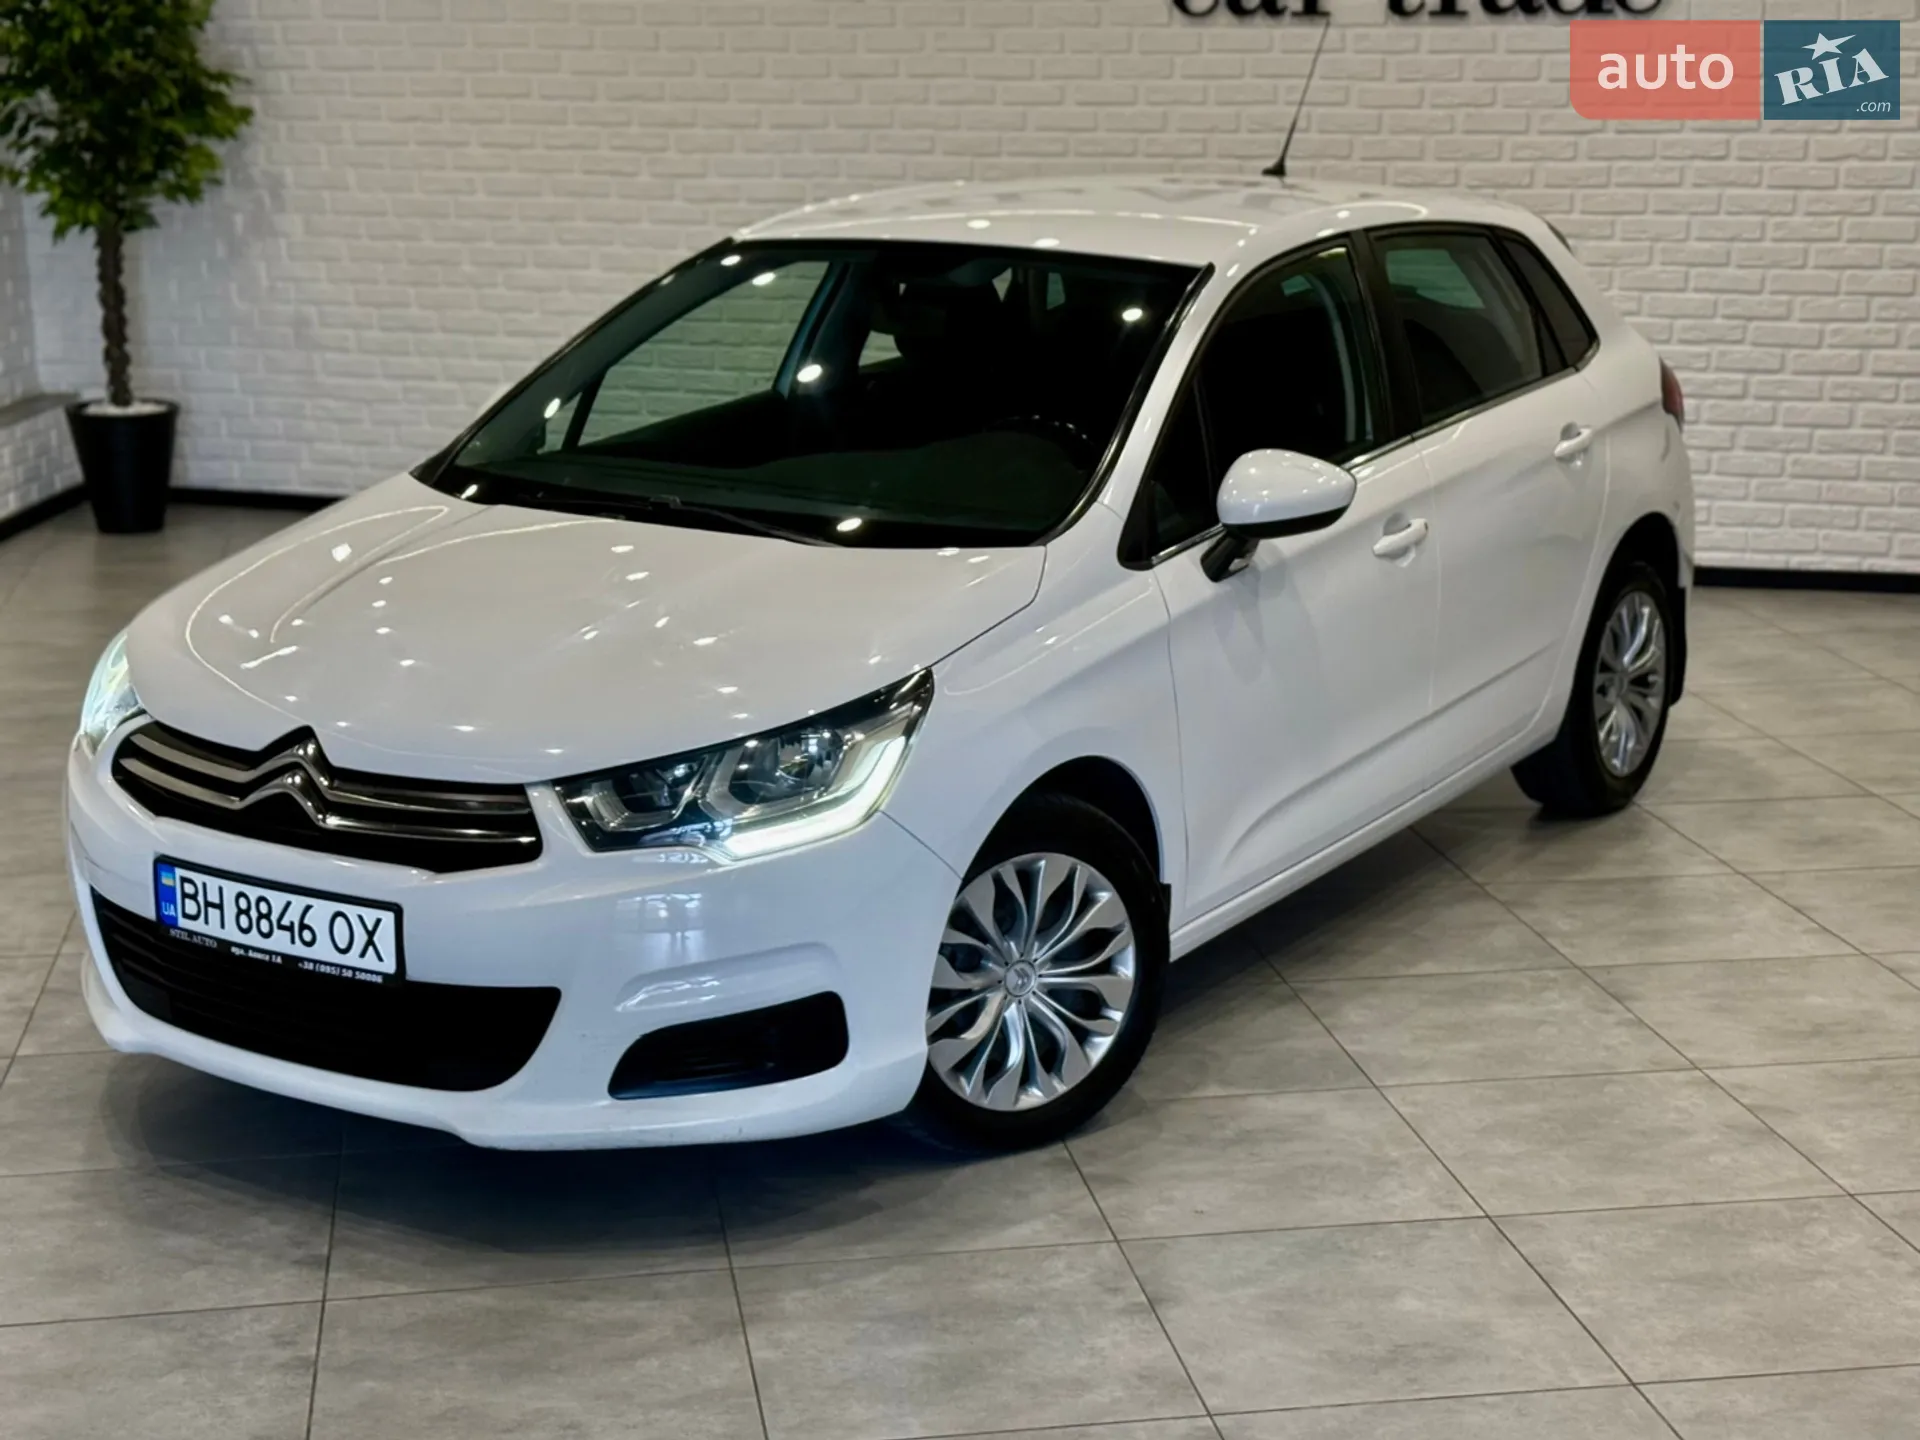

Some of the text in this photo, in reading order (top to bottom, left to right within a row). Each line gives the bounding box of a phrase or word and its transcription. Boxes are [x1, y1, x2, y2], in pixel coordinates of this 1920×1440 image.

[162, 902, 177, 917] UA
[179, 875, 385, 963] BH 8846 OX
